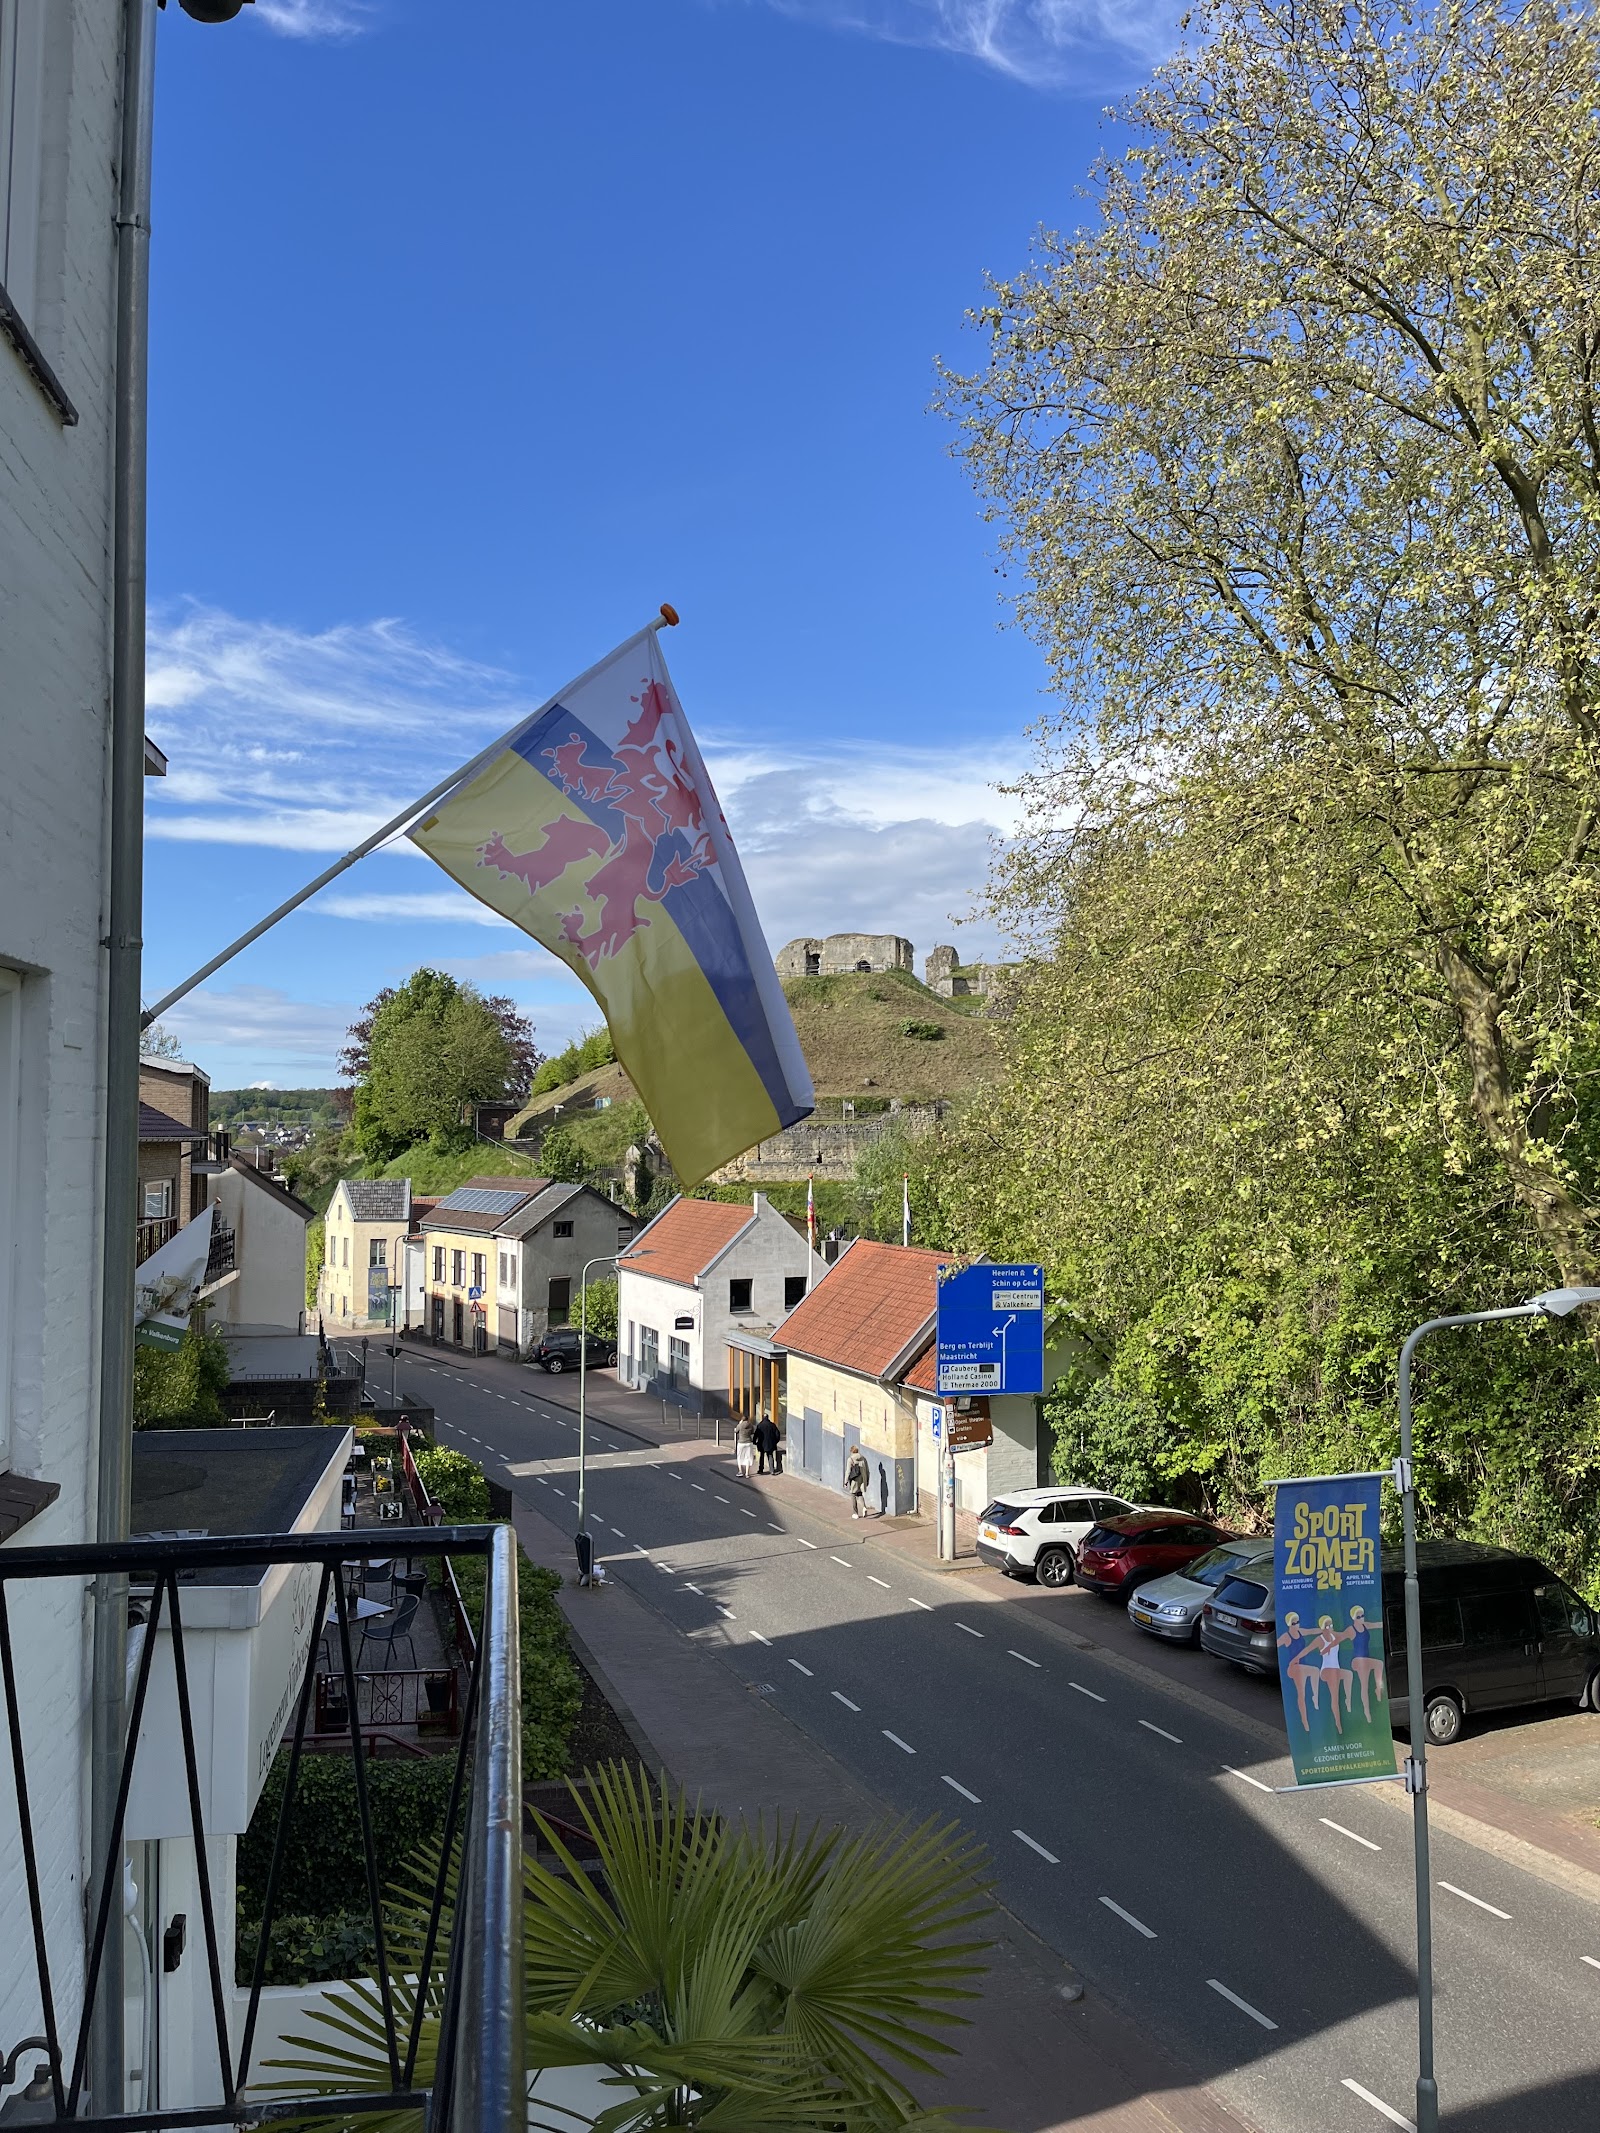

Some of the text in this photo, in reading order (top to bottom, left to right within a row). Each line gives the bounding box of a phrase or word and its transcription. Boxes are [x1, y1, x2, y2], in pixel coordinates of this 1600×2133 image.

[992, 1279, 1010, 1287] Schin
[1022, 1279, 1038, 1287] Geul
[149, 1329, 180, 1344] Valkenburg
[940, 1343, 956, 1351] Berg
[968, 1341, 994, 1351] Terblijt
[940, 1352, 978, 1360] Maastricht
[950, 1365, 978, 1373] Cauberg
[942, 1372, 992, 1381] Holland Casino
[951, 1380, 998, 1389] Thermae 2000
[1294, 1502, 1366, 1540] SPORT
[1285, 1537, 1375, 1576] ZOMER
[1316, 1567, 1343, 1590] 24
[1314, 1750, 1375, 1763] GEZONDER BEWEGEN
[1301, 1760, 1390, 1775] SPORTZOMERVALKENBURG.NL
